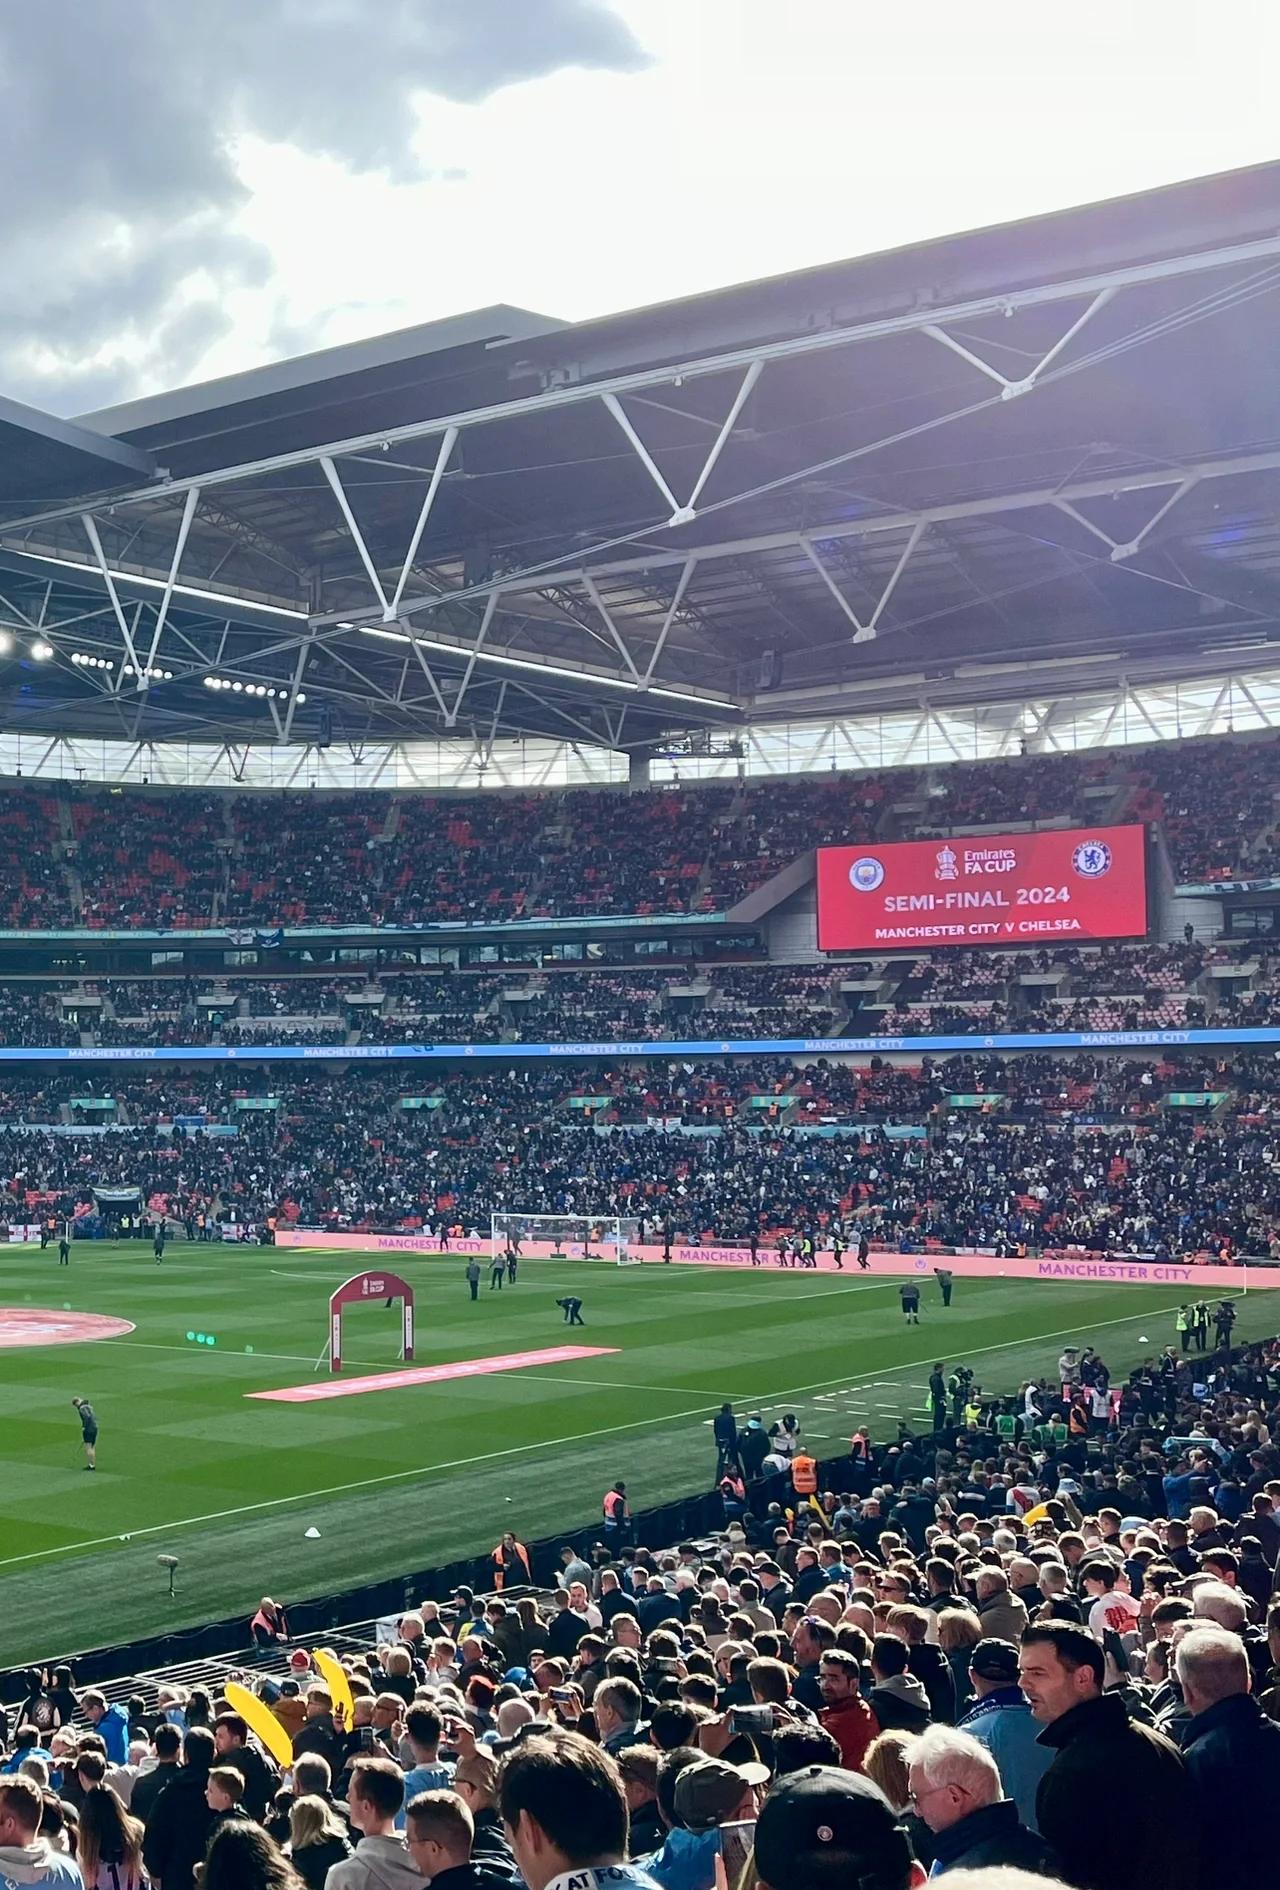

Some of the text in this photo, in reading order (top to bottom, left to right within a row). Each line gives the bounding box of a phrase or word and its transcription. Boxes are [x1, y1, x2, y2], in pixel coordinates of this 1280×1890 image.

[964, 849, 1016, 862] Emirates
[964, 860, 1016, 874] FA CUP
[884, 887, 1070, 912] SEMI-FINAL 2024
[875, 919, 1081, 939] MANCHESTER CITY V CHELSEA
[1080, 1032, 1191, 1044] MANCHESTER CITY
[550, 1044, 644, 1054] MANCHESTER CITY
[805, 1039, 905, 1050] MANCHESTER CITY
[68, 1049, 156, 1058] MANCHESTER CITY
[304, 1048, 368, 1057] MANCHESTER
[457, 1241, 482, 1252] CITY
[1038, 1263, 1192, 1280] MANCHESTER CITY
